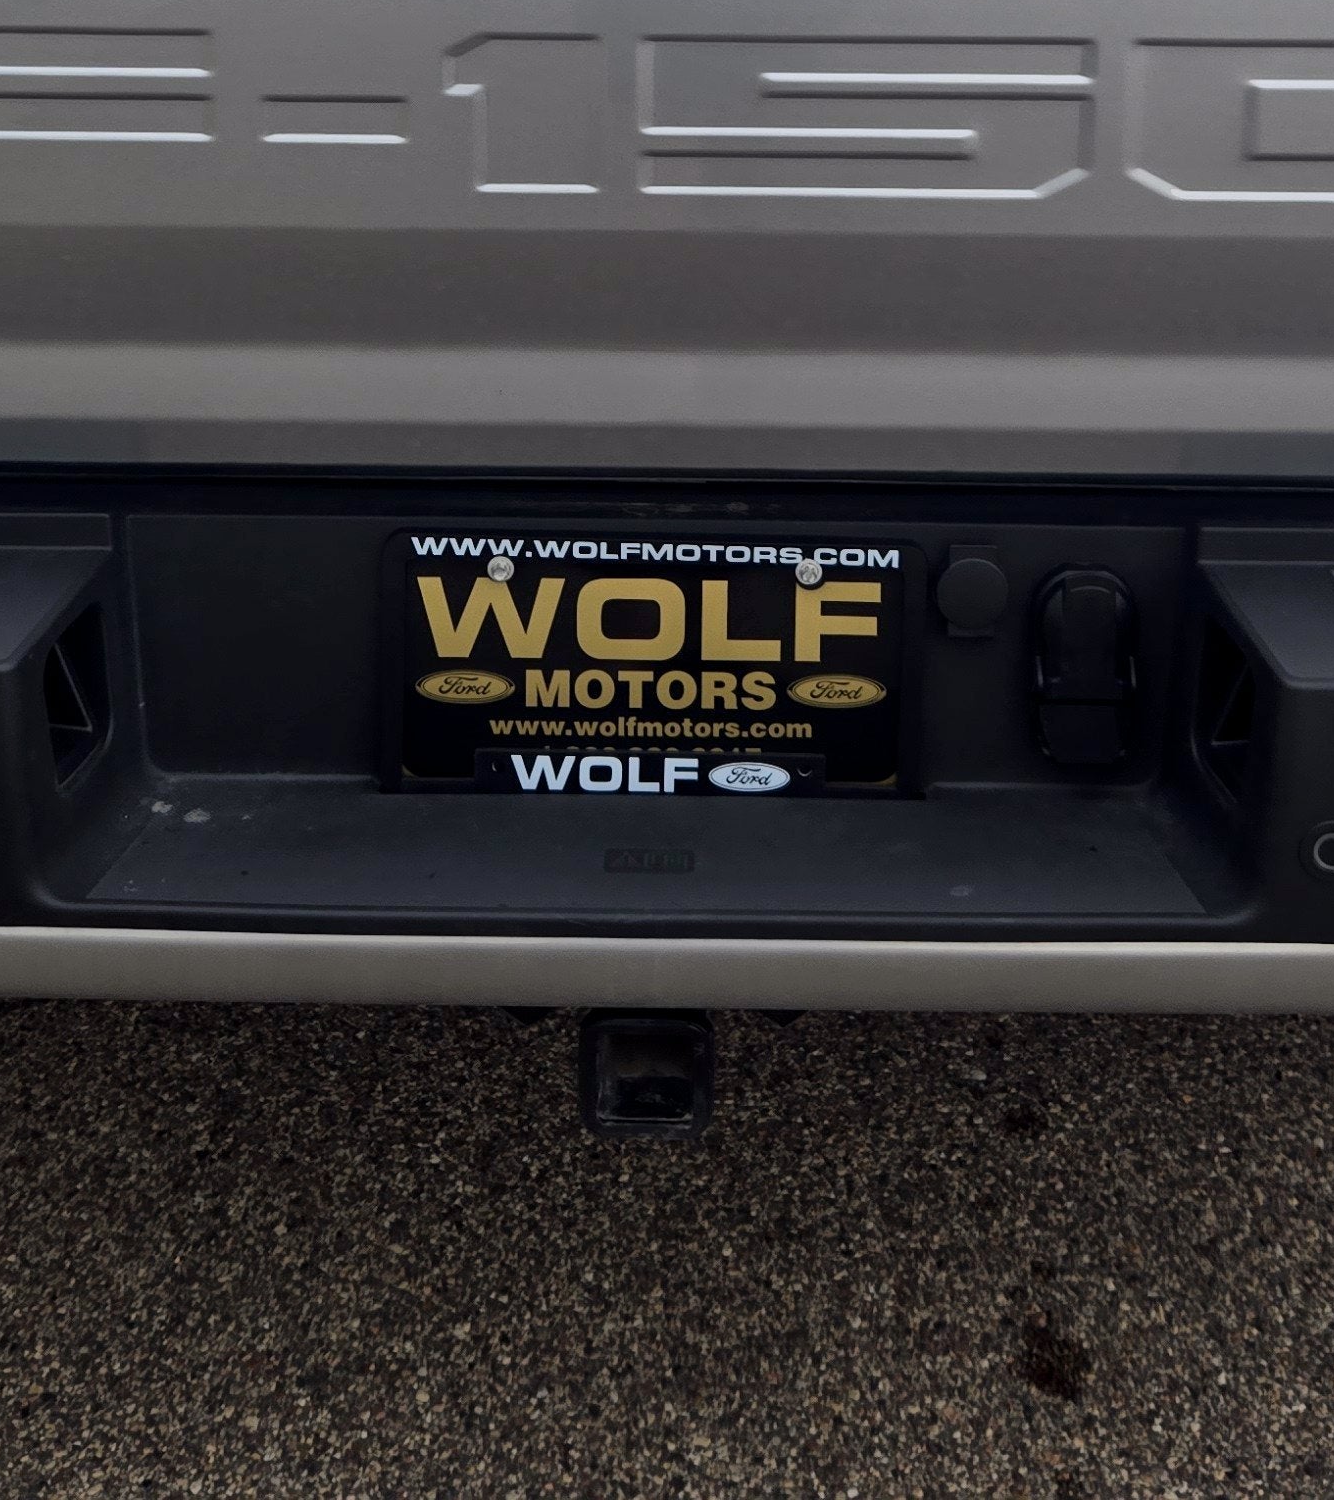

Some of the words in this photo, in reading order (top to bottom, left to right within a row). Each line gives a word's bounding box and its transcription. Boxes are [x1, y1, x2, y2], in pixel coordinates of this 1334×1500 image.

[411, 536, 900, 569] WWW.WOLFMOTORSCOM
[416, 576, 882, 663] WOLF
[525, 669, 777, 711] MOTORS
[489, 716, 813, 738] www.wolfmotors.com
[511, 754, 699, 793] WOLF
